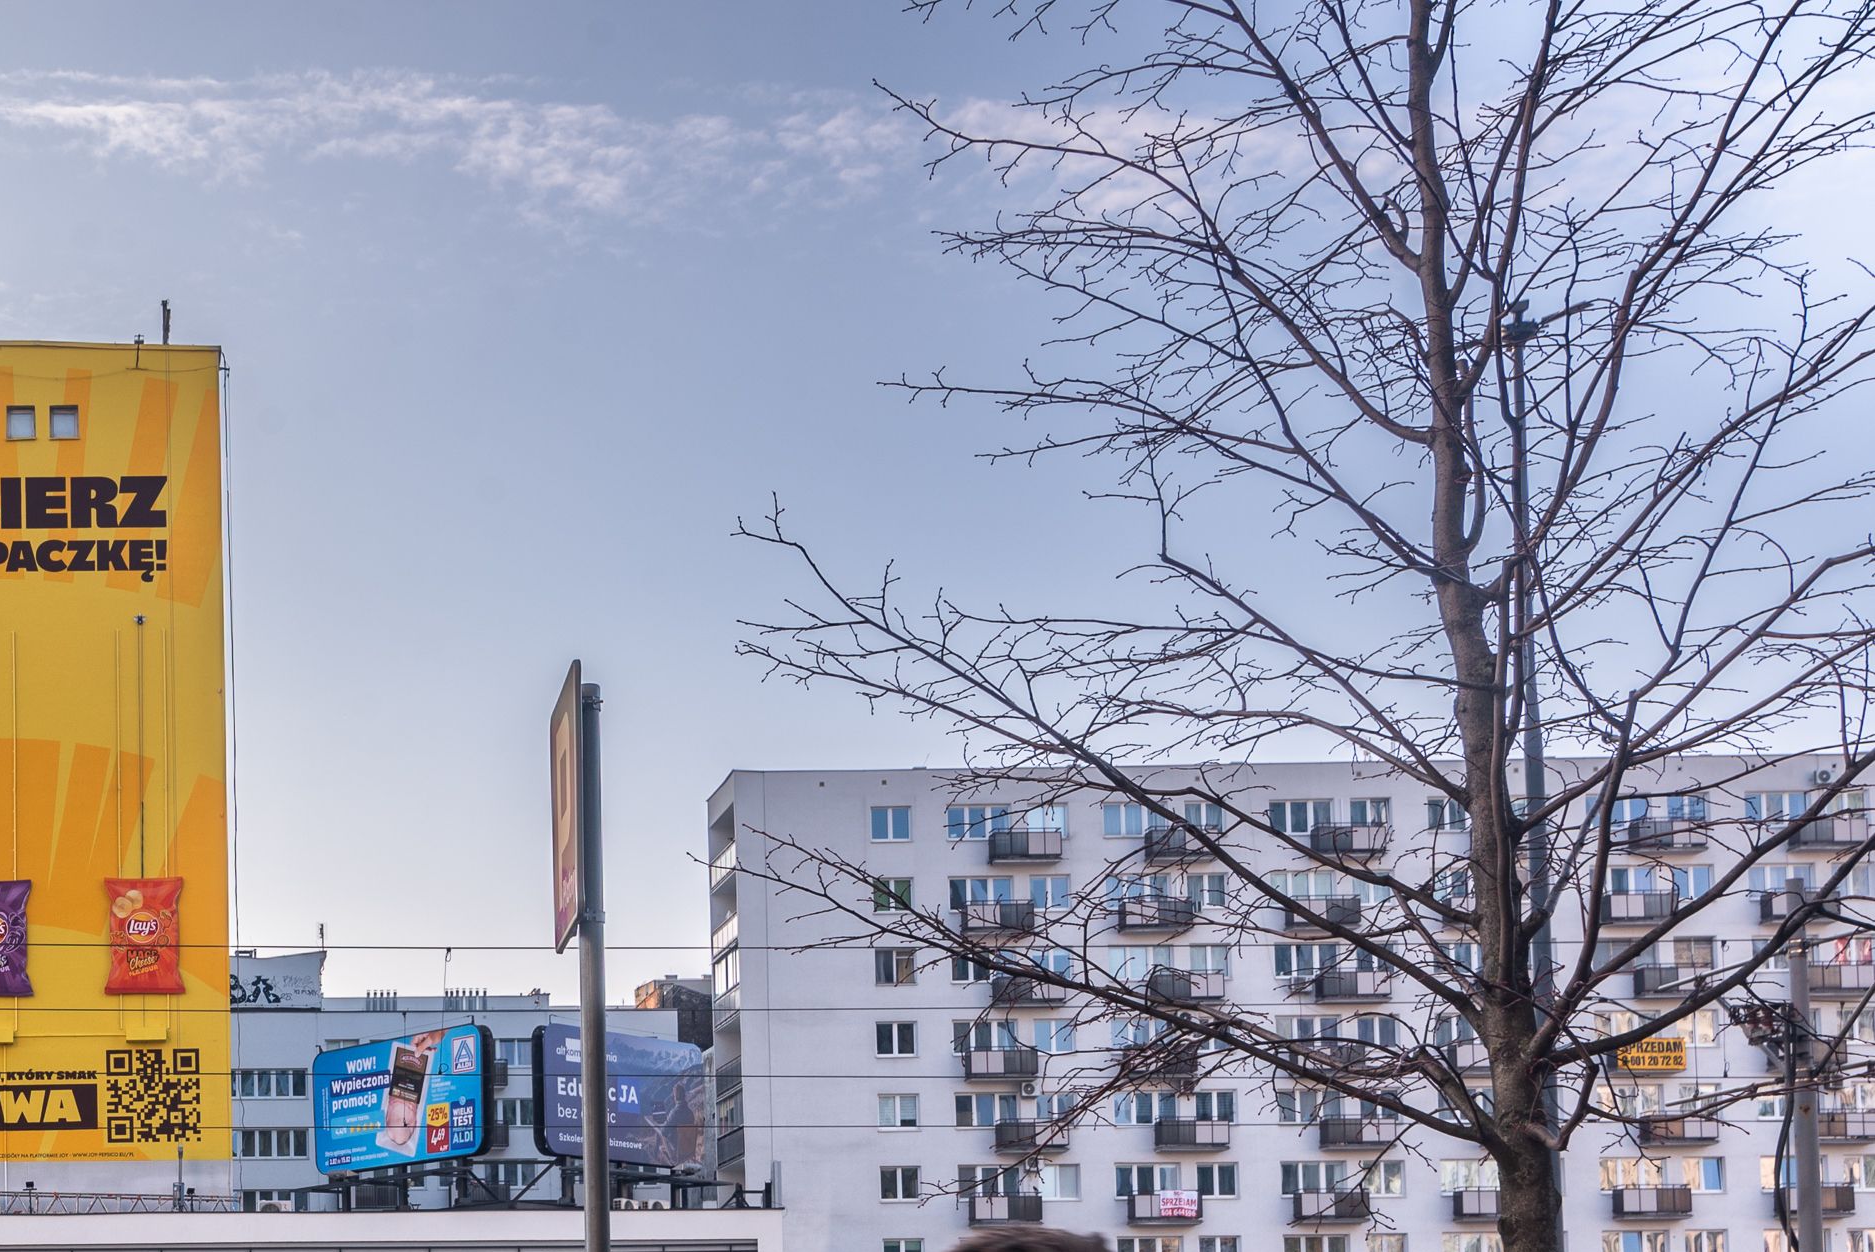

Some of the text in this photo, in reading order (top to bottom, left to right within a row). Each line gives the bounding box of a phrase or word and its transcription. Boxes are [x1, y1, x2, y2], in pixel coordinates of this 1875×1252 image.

[129, 919, 156, 936] Lay's
[346, 1056, 377, 1074] WOW!
[456, 1062, 472, 1070] ALDI
[1648, 1056, 1658, 1066] 20
[1661, 1056, 1671, 1066] 72
[6, 1069, 55, 1081] KTÓRY
[57, 1070, 98, 1080] SMAK
[331, 1074, 390, 1095] Wypieczona
[332, 1091, 377, 1114] promocja
[428, 1107, 448, 1121] -25%
[453, 1106, 473, 1115] WIELKI
[558, 1103, 577, 1119] bez
[453, 1115, 473, 1126] TEST
[453, 1130, 473, 1144] ALDI
[609, 1138, 642, 1149] biznesowe
[1161, 1198, 1197, 1206] SPRZEAM
